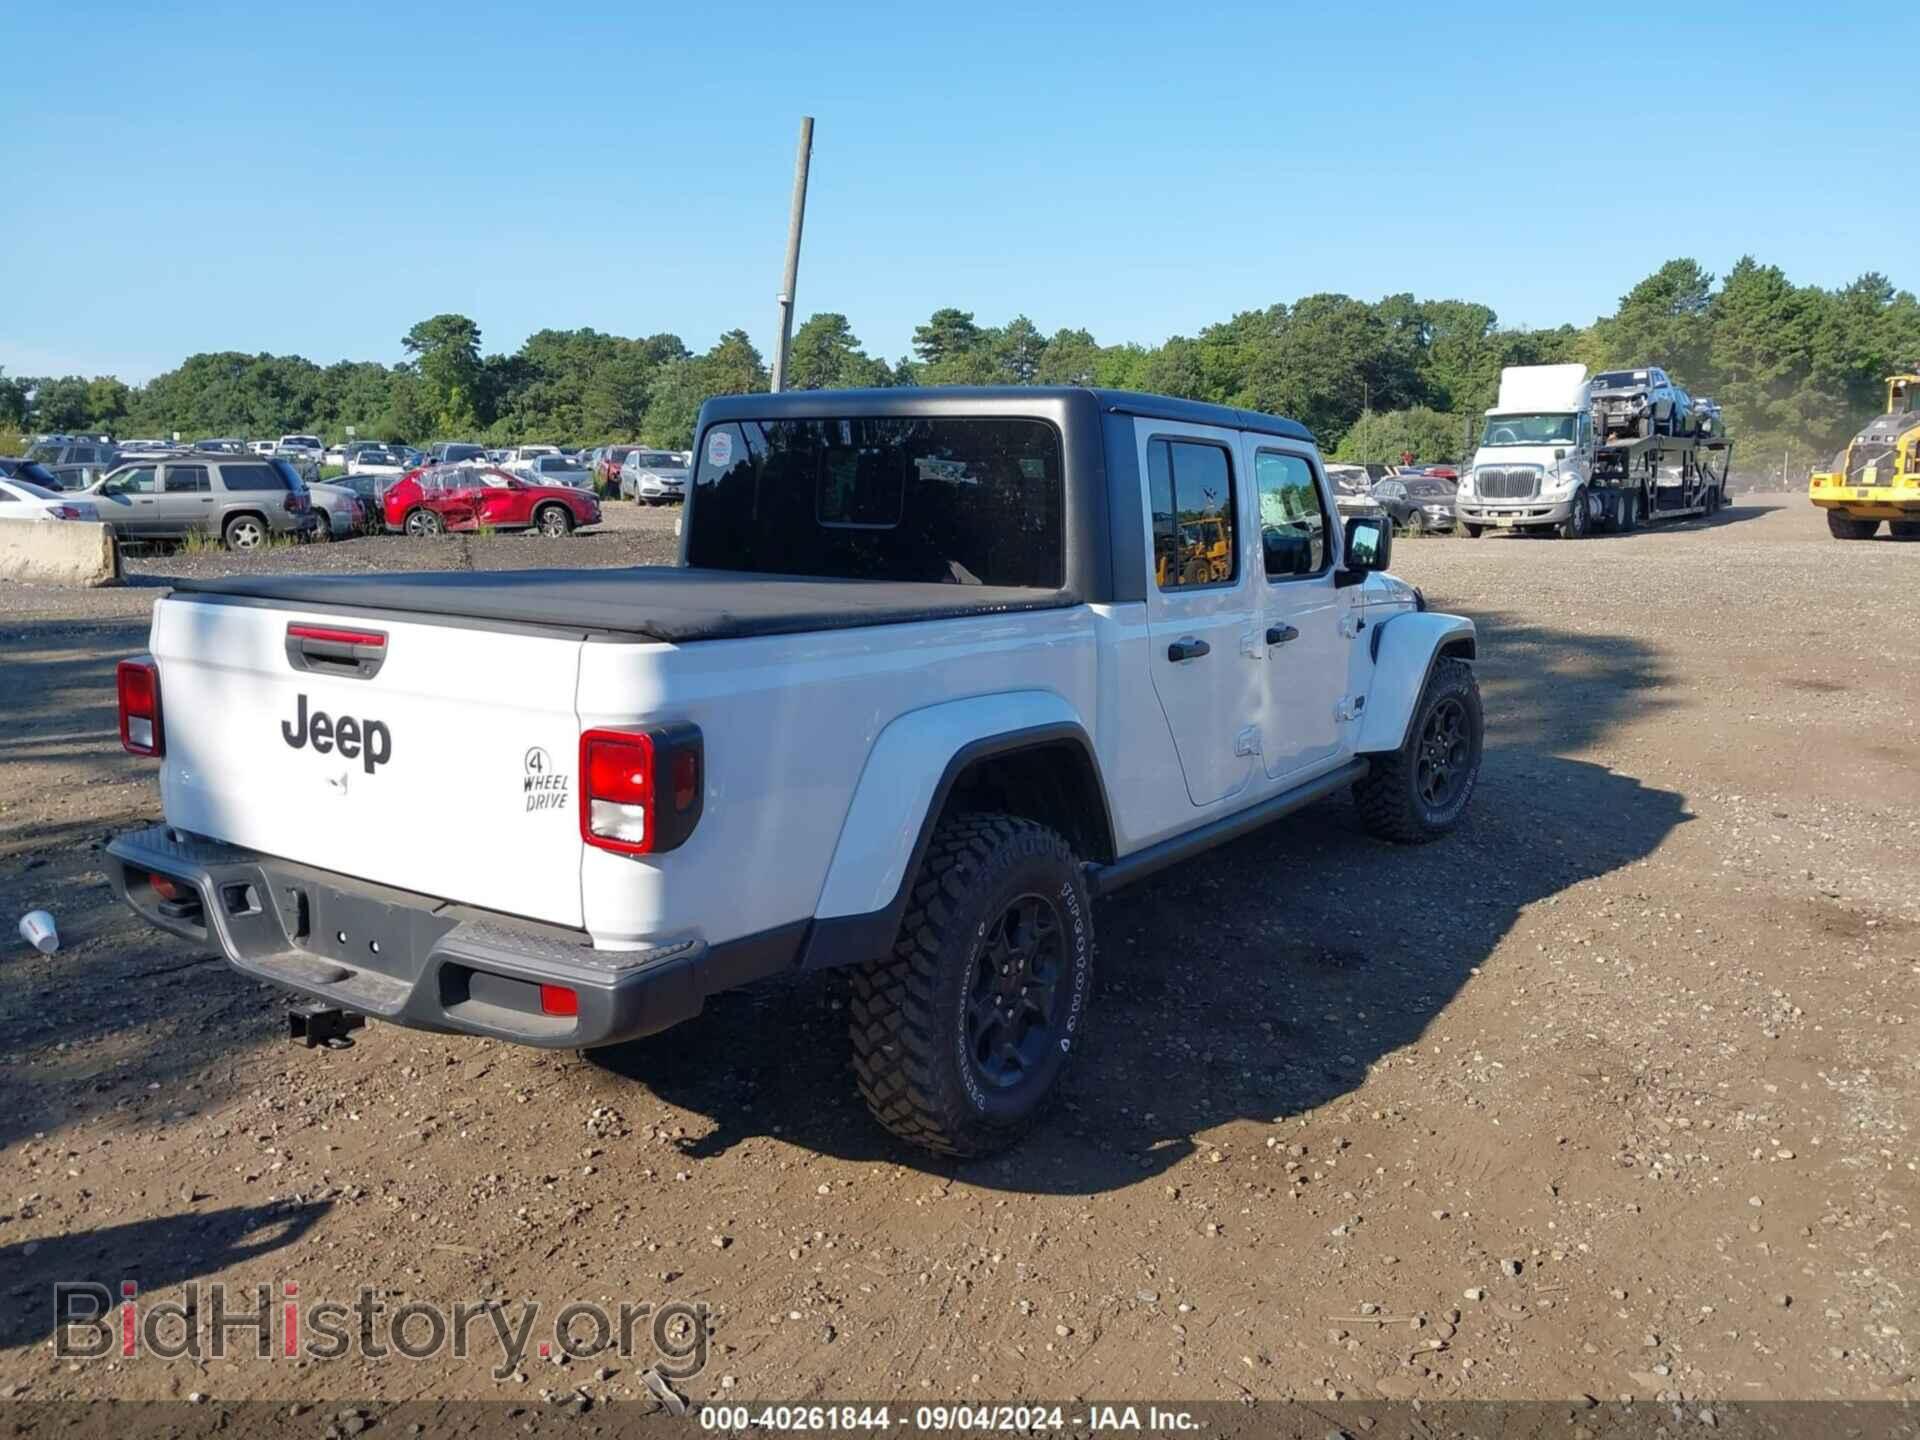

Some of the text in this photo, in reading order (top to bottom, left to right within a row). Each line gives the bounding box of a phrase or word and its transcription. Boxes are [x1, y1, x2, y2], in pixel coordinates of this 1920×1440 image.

[281, 693, 392, 775] Jeep
[524, 775, 569, 792] WHEEL
[526, 793, 569, 813] DRIVE
